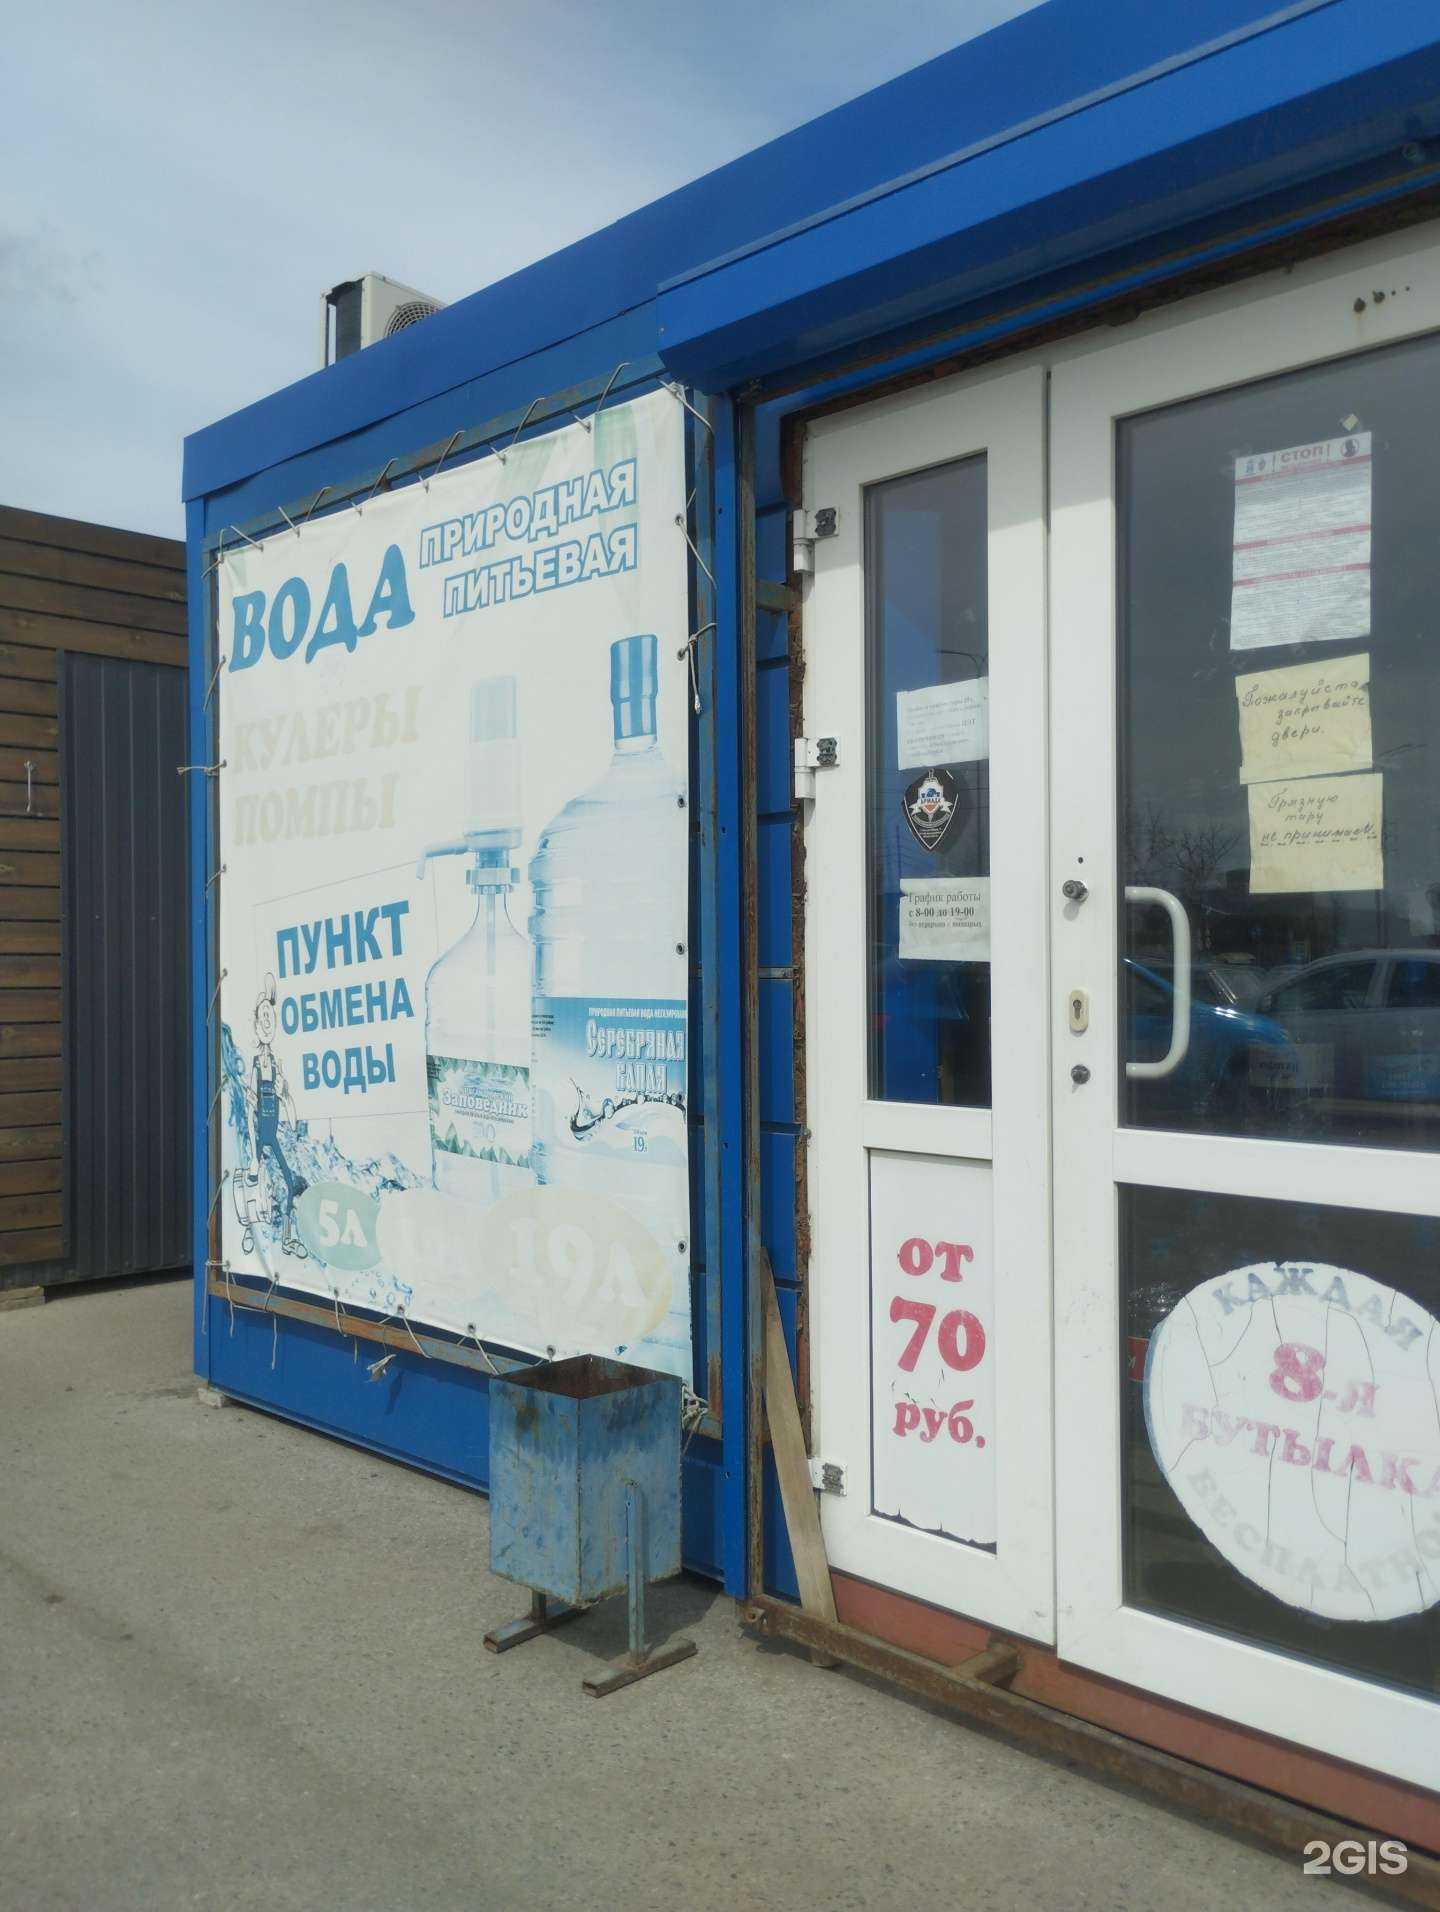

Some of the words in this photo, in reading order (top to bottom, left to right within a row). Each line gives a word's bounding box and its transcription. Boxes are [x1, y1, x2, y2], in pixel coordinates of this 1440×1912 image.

[418, 457, 637, 570] ПРИРОДНАЯ
[443, 522, 637, 618] ПИТЬЕВАЯ
[228, 543, 416, 673] ВОДА
[232, 685, 424, 774] КУЛЕРЫ
[232, 772, 400, 846] ПОМПЫ
[1262, 831, 1278, 842] не
[908, 892, 943, 905] График
[946, 891, 982, 905] работы
[915, 907, 935, 918] 8-00
[936, 908, 948, 918] до
[950, 906, 975, 917] 19-00
[276, 900, 410, 979] ПУНКТ
[281, 978, 414, 1036] ОБМЕНА
[302, 1043, 396, 1095] ВОДЫ
[898, 1237, 974, 1283] от
[890, 1295, 986, 1372] 70
[892, 1399, 985, 1449] руб.
